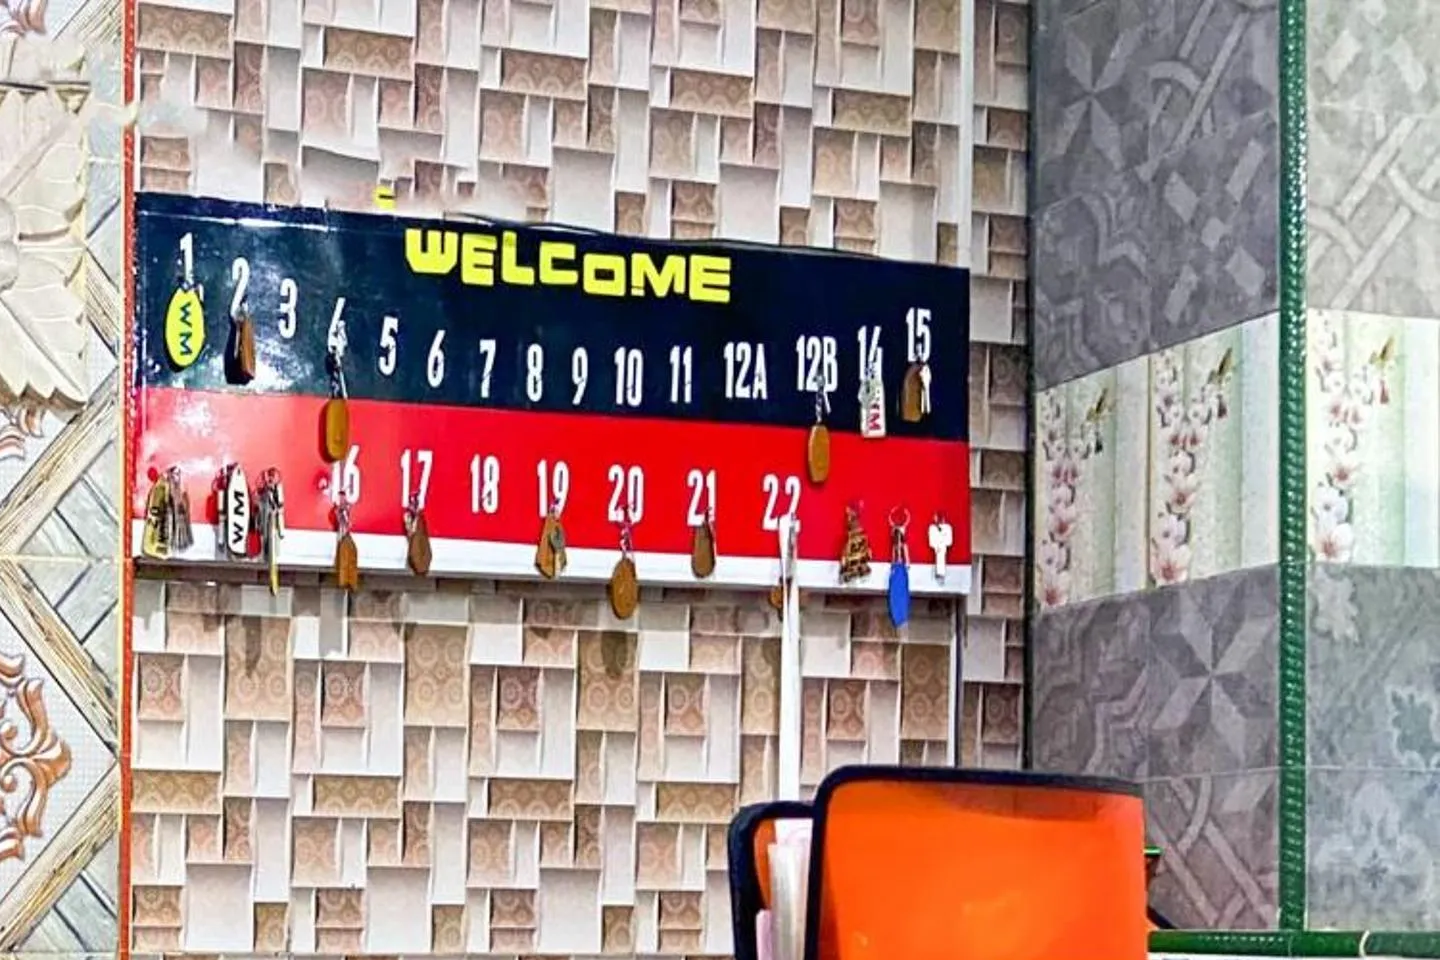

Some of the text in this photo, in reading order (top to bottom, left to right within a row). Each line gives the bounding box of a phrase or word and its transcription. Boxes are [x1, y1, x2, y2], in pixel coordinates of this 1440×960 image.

[405, 228, 731, 303] WELCOME
[179, 232, 194, 283] 1
[230, 257, 250, 321] 2
[279, 278, 298, 338] 3
[378, 316, 398, 375] 5
[428, 330, 446, 388] 6
[479, 339, 496, 398] 7
[526, 344, 543, 402] 8
[572, 347, 588, 405] 9
[614, 346, 644, 406] 10
[669, 346, 693, 404] 11
[724, 342, 768, 400] 12A
[796, 335, 838, 392] 12B
[858, 326, 883, 382] 14
[906, 307, 932, 363] 15
[331, 445, 801, 532] 16 17 18 19 20 21 22
